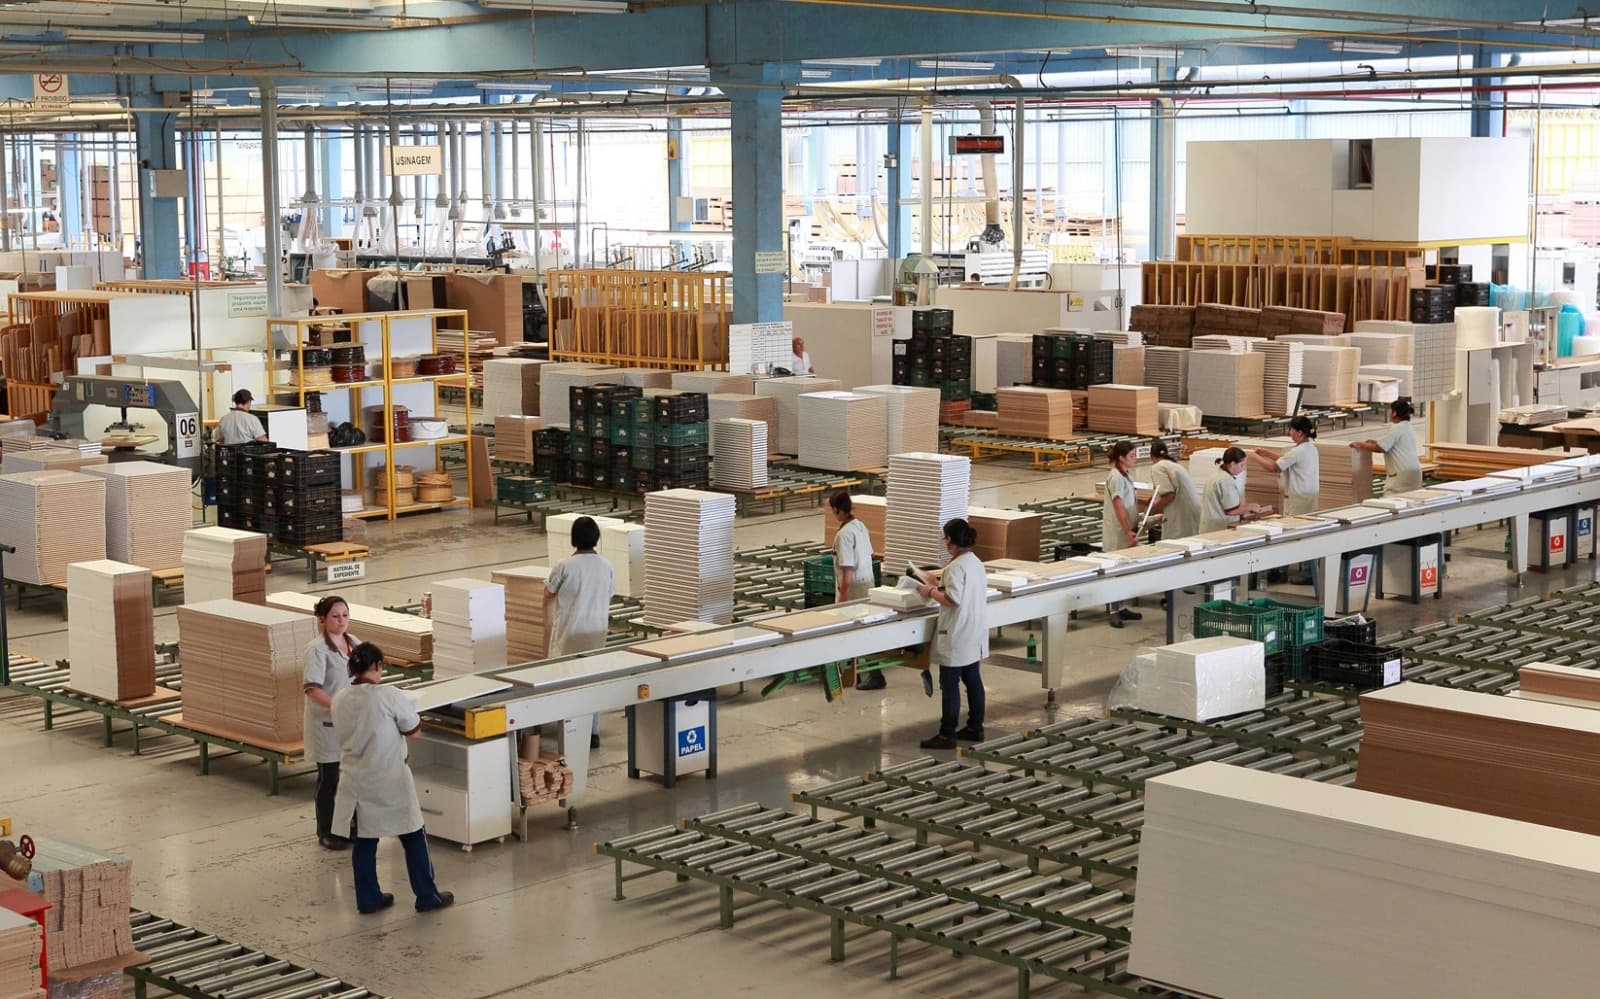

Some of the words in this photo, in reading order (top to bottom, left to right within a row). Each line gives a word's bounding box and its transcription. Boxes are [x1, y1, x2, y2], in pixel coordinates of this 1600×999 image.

[395, 155, 432, 166] USINAGEM
[180, 418, 196, 436] 06
[332, 564, 354, 573] MATERIAL
[333, 570, 360, 579] EXPEDIENTE
[681, 743, 704, 755] PAPEL
